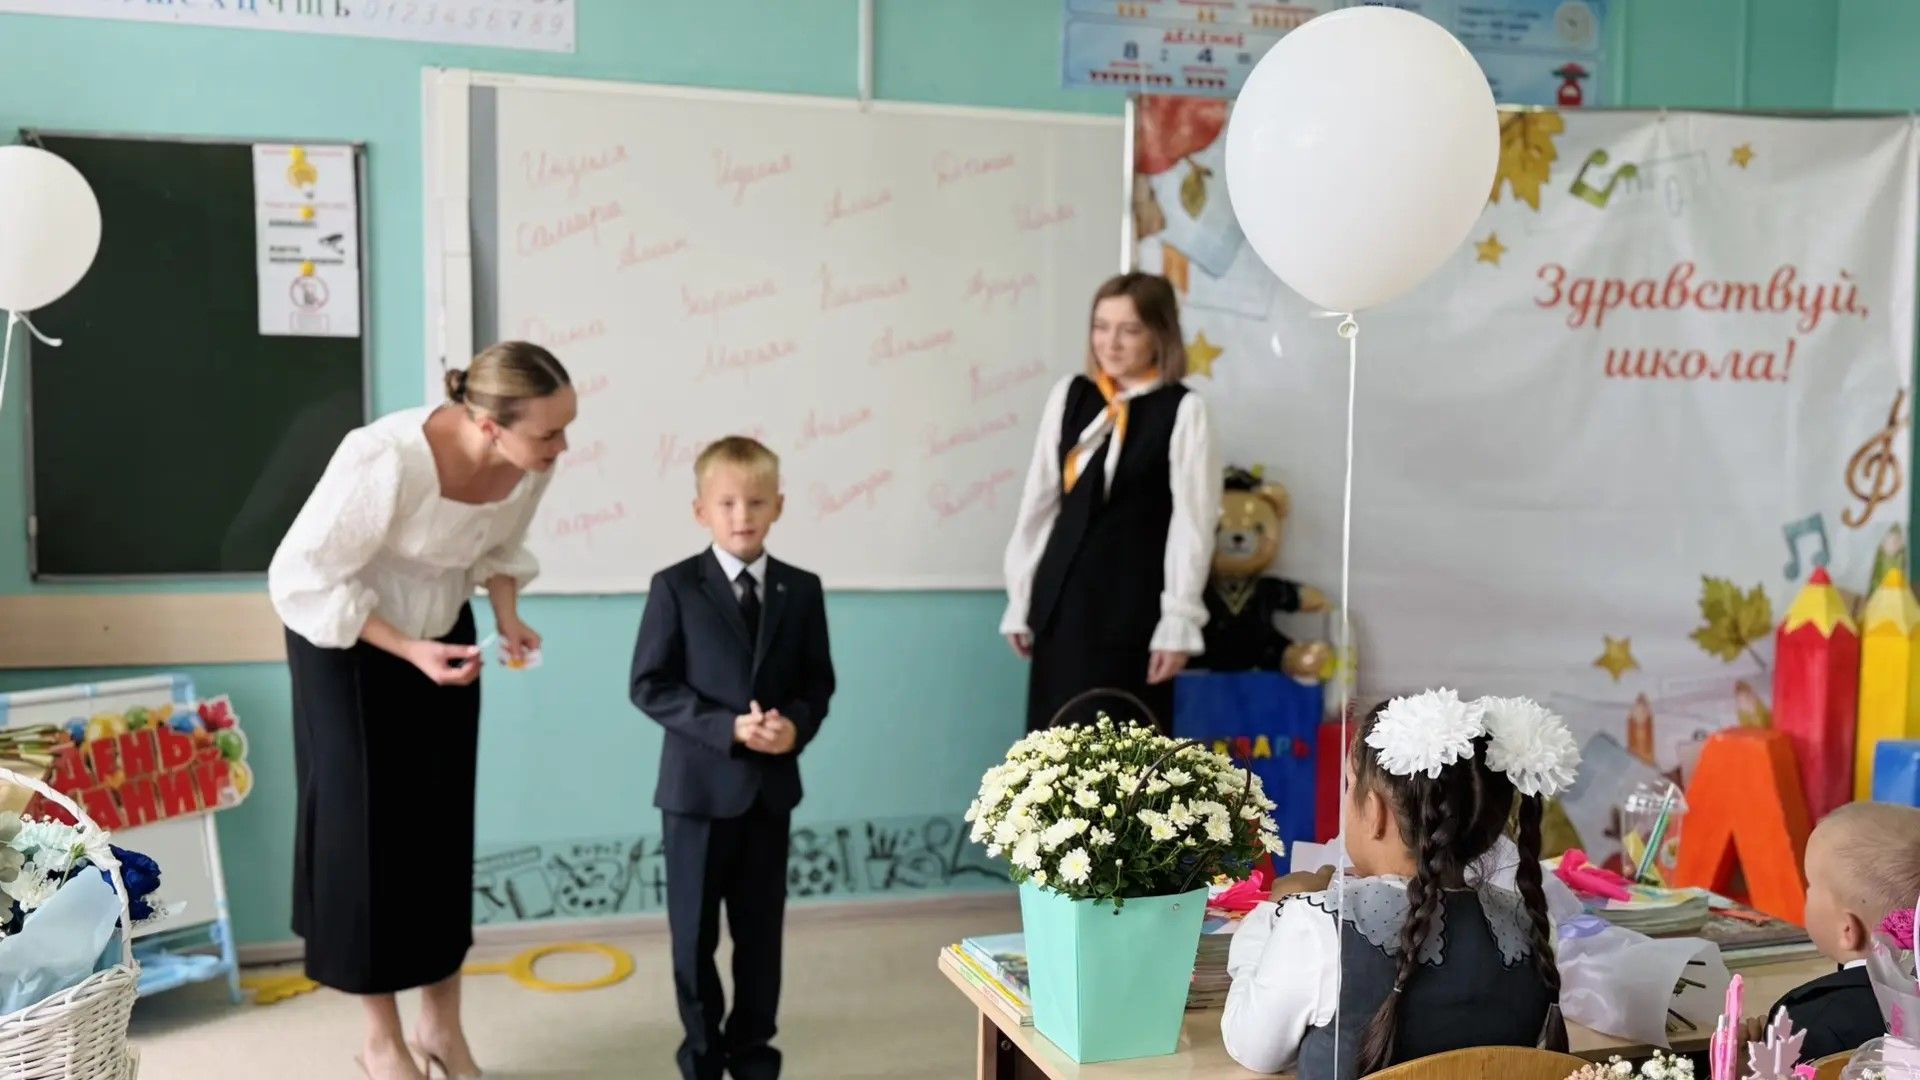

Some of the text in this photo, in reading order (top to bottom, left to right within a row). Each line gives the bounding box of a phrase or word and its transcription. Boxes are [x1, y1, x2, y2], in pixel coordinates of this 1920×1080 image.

[1533, 261, 1870, 333] Здравствуй,
[1603, 338, 1796, 382] школа!
[51, 724, 195, 794] ДЕНЬ
